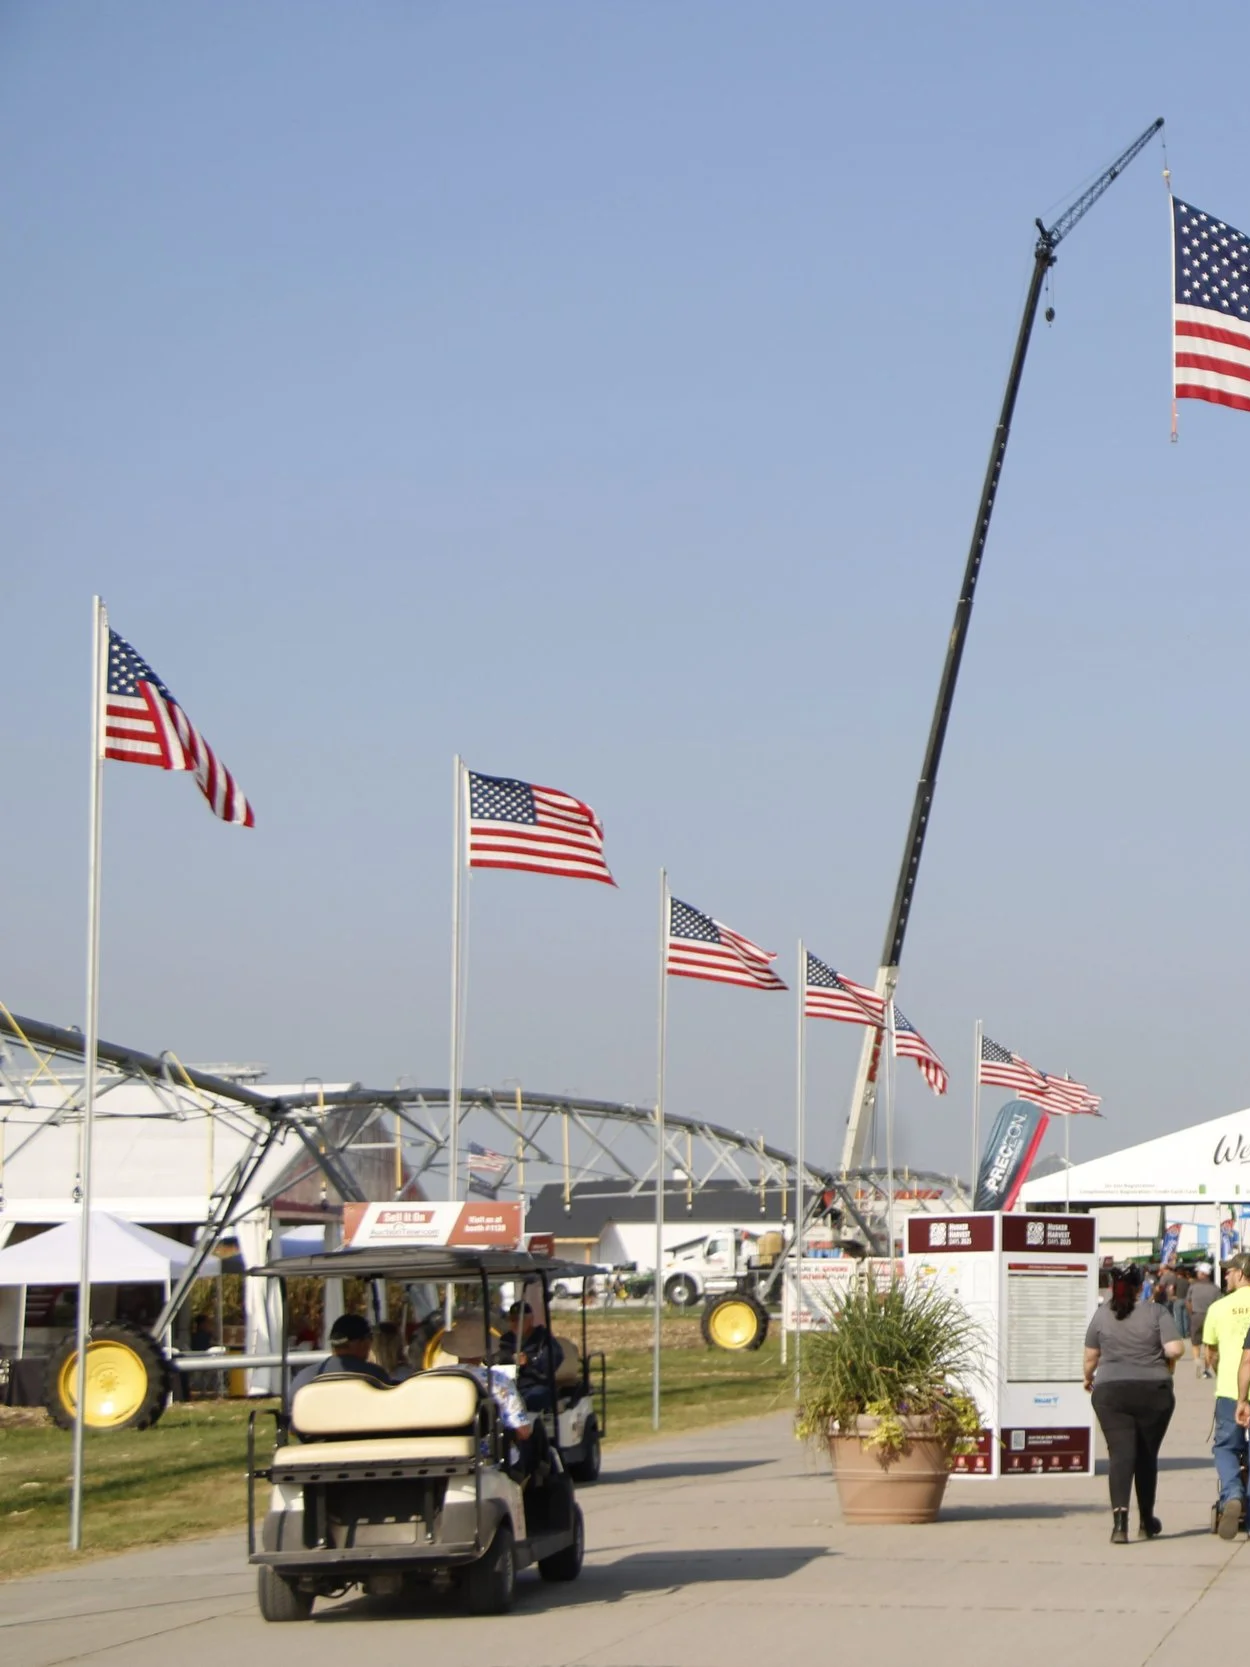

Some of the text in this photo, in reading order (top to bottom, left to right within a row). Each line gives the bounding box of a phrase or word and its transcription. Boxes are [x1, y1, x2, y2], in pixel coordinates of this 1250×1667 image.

[948, 1223, 969, 1231] HUSKER
[1047, 1223, 1068, 1231] HUSKER
[948, 1230, 971, 1238] HARVEST
